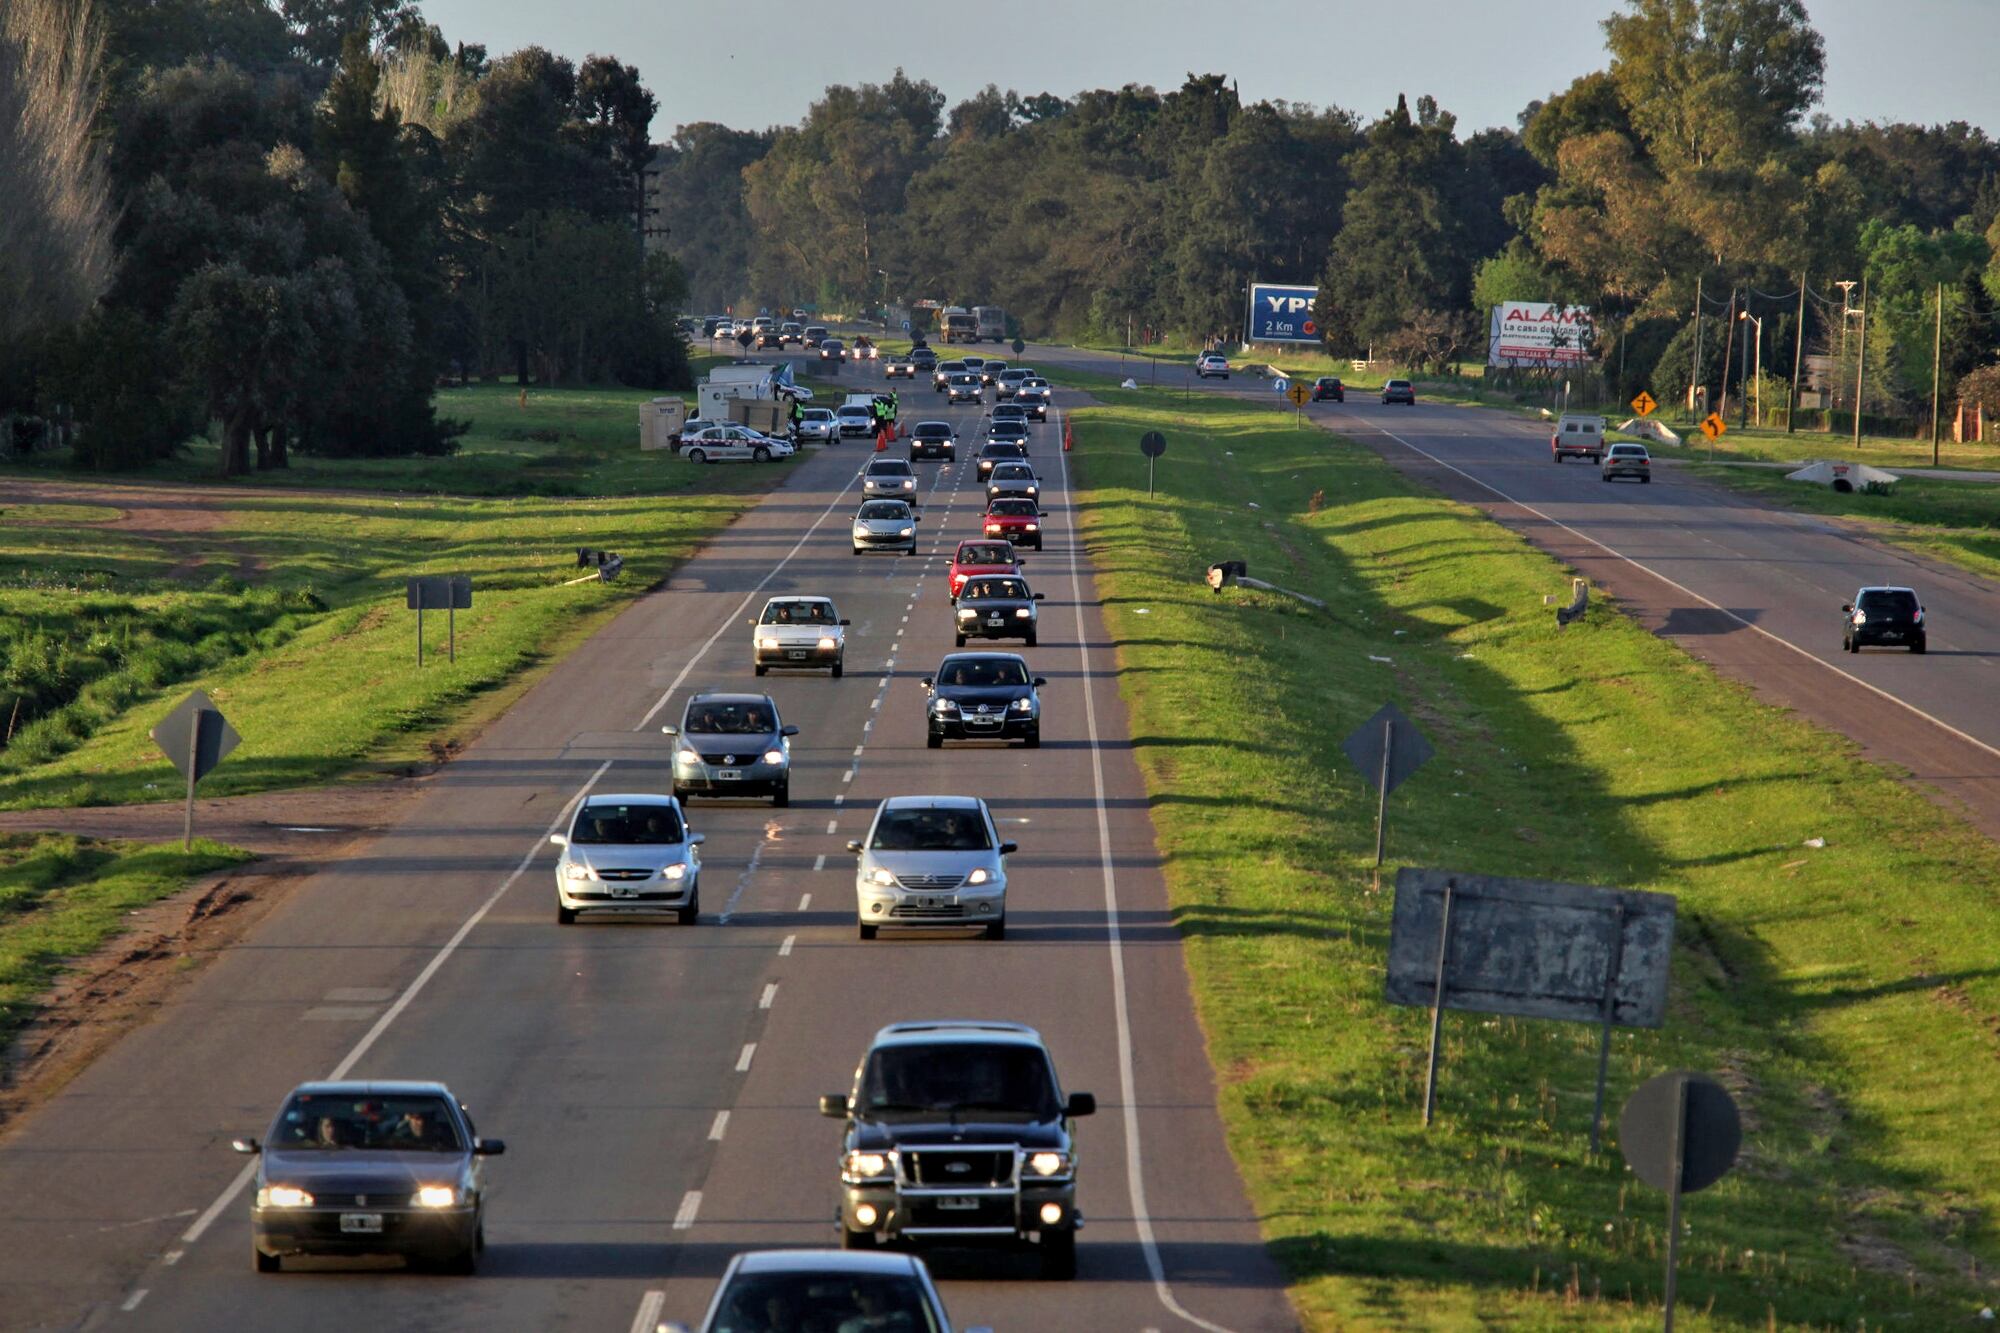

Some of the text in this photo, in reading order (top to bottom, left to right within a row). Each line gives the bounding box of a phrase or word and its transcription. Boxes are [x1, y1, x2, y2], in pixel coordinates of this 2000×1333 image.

[1266, 321, 1293, 331] 2 Km
[1504, 323, 1515, 331] La
